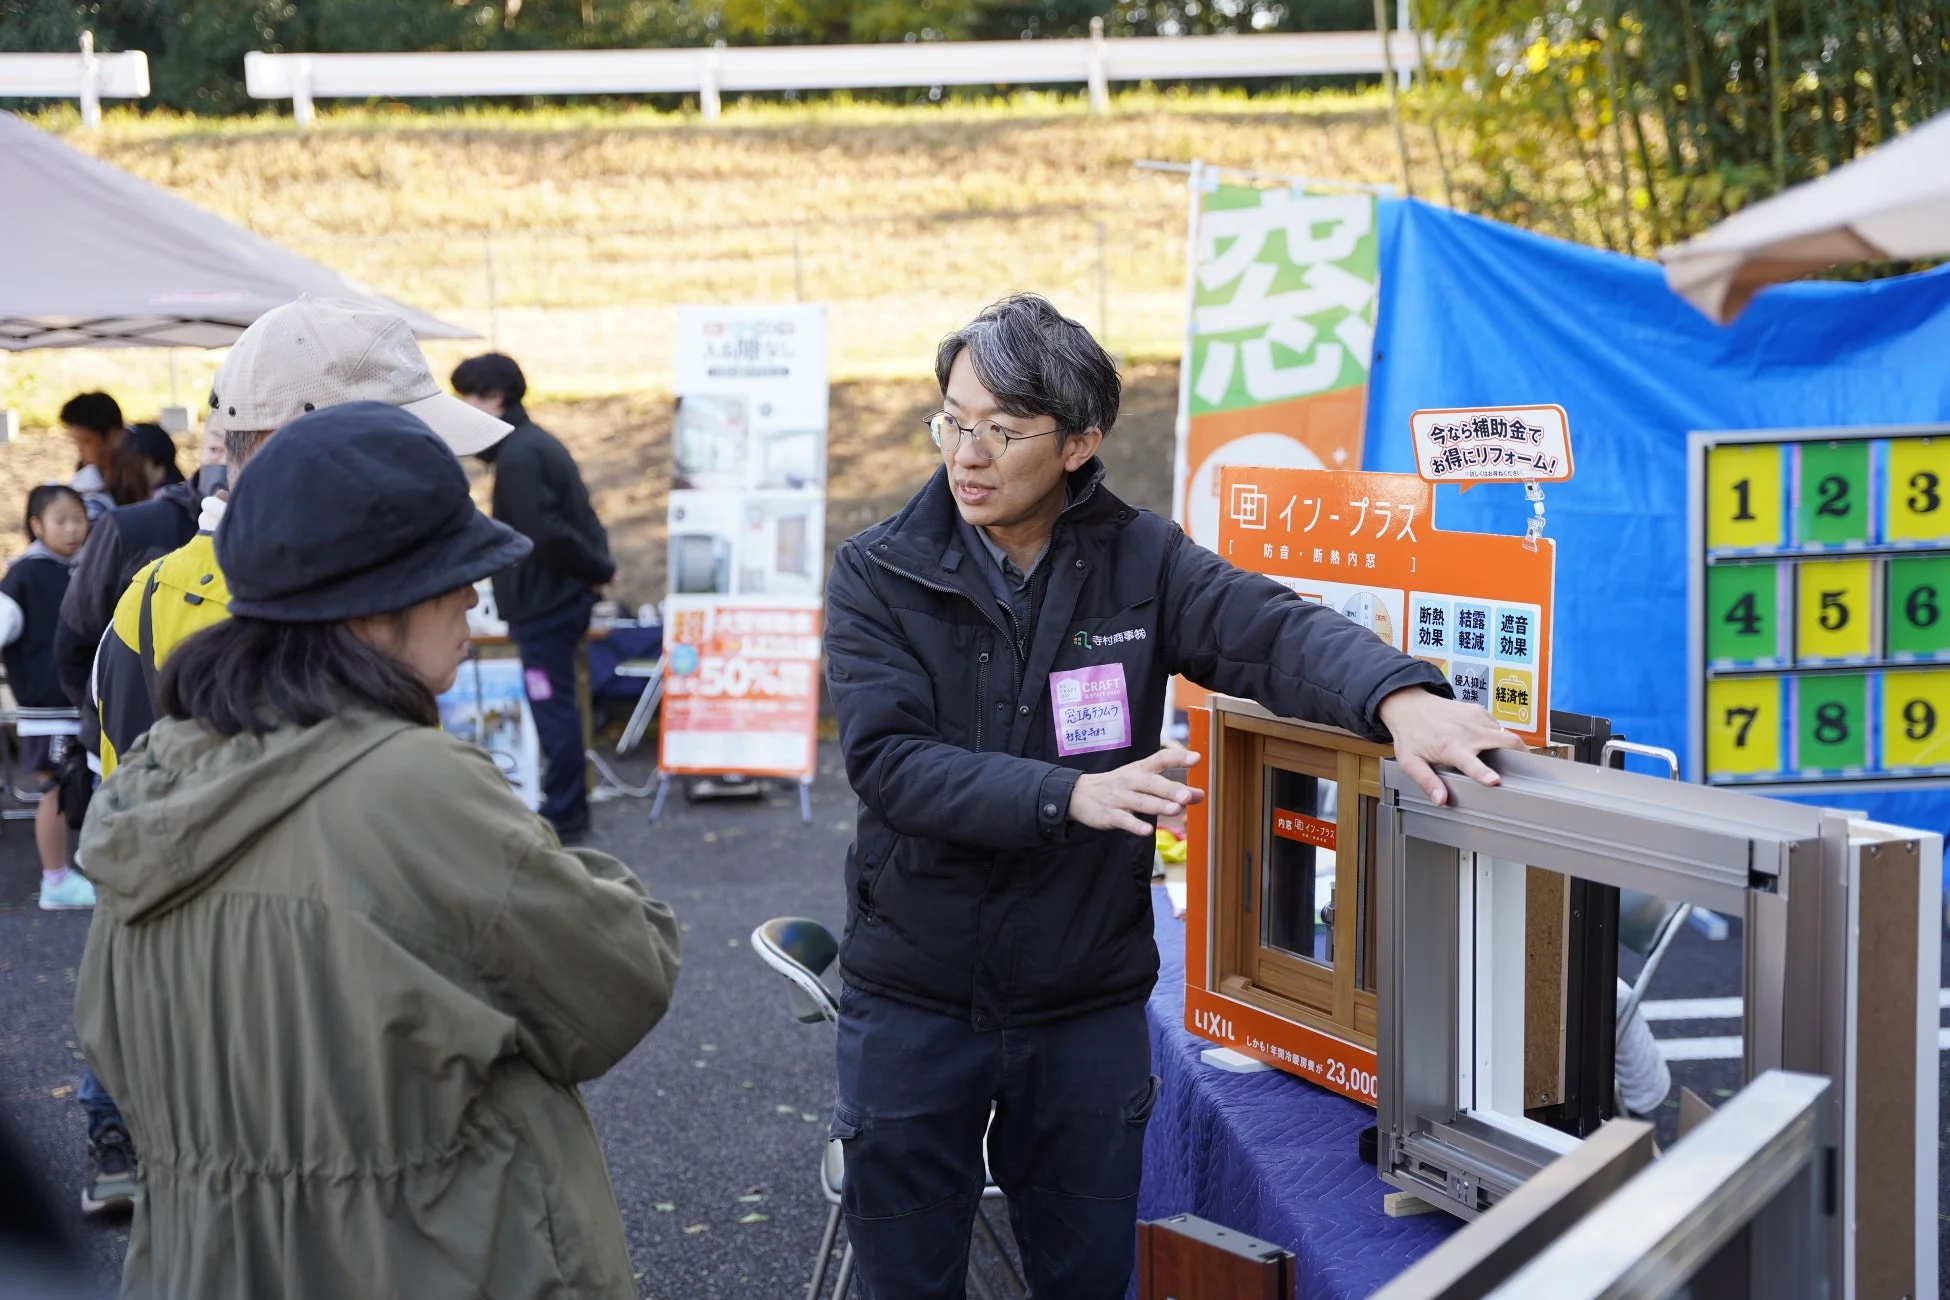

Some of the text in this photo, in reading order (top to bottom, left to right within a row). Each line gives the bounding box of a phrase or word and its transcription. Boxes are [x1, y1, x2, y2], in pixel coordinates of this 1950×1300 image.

[1194, 190, 1376, 406] 窓
[1430, 417, 1542, 445] 今なら補助金で
[1432, 447, 1557, 475] お得にリフォーム！
[1730, 471, 1941, 521] 1 2 3
[1263, 543, 1376, 569] 防音・断熱内窓
[1419, 606, 1445, 627] 断熱
[1458, 609, 1486, 631] 結露
[1724, 585, 1940, 636] 4 5 6
[1500, 613, 1529, 636] 遮音
[1418, 626, 1444, 648] 効果
[1458, 630, 1485, 652] 軽減
[1500, 635, 1528, 658] 効果
[1082, 678, 1121, 693] CRAFT
[1454, 674, 1487, 691] 侵入抑止
[1462, 688, 1479, 702] 効果
[1495, 686, 1529, 706] 経済性
[1725, 698, 1937, 749] 7 8 9
[1194, 1008, 1235, 1042] LIXIL
